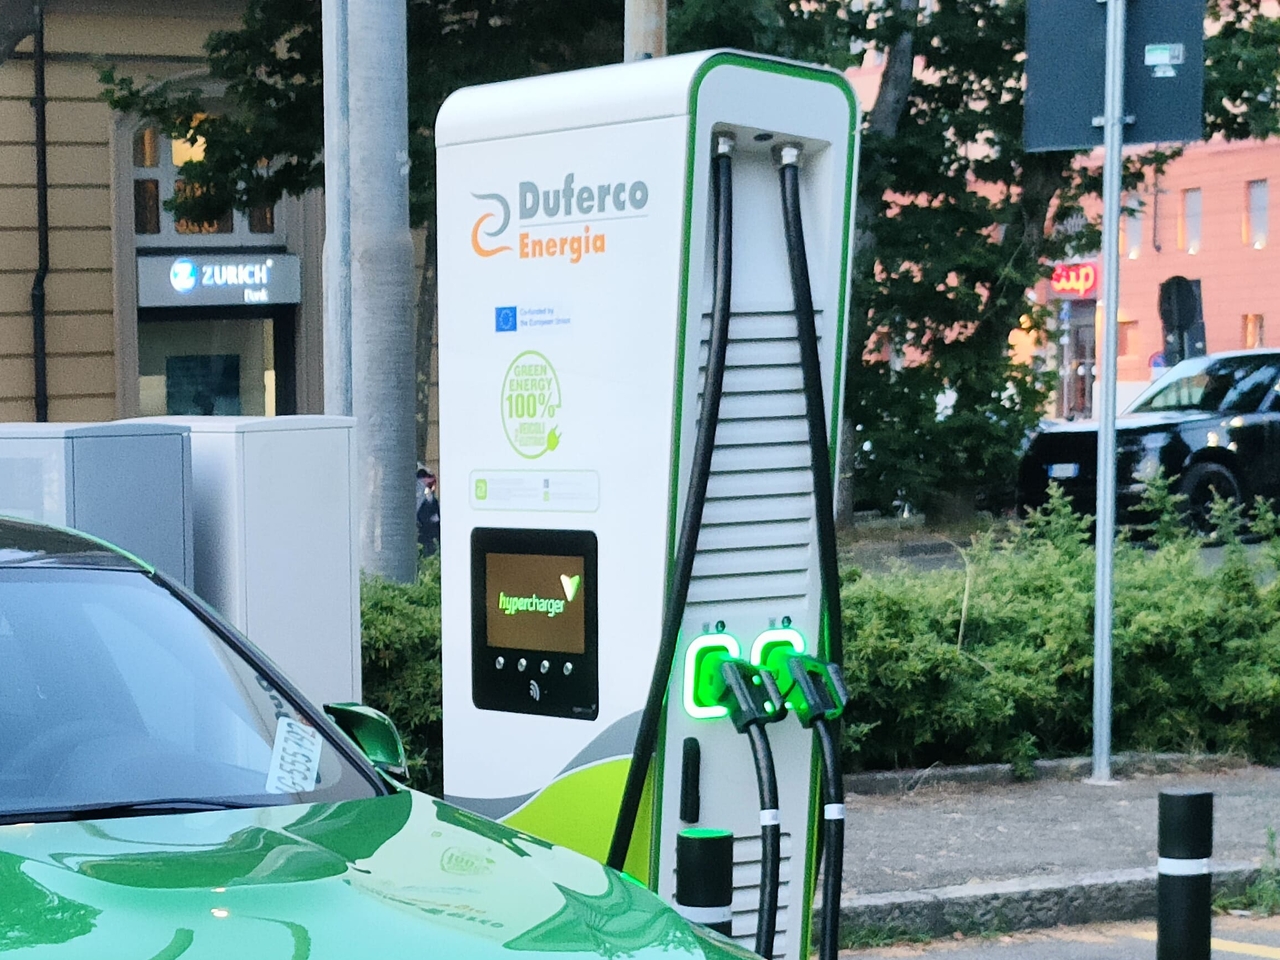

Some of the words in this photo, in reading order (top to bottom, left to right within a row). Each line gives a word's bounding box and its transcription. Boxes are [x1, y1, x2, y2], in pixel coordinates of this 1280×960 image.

[519, 173, 649, 220] Duferco
[519, 225, 606, 264] Energia
[202, 264, 269, 285] ZURICH
[514, 364, 547, 377] GREEN
[509, 378, 552, 391] ENERGY
[506, 392, 555, 418] 100%
[499, 592, 565, 617] hypercharger
